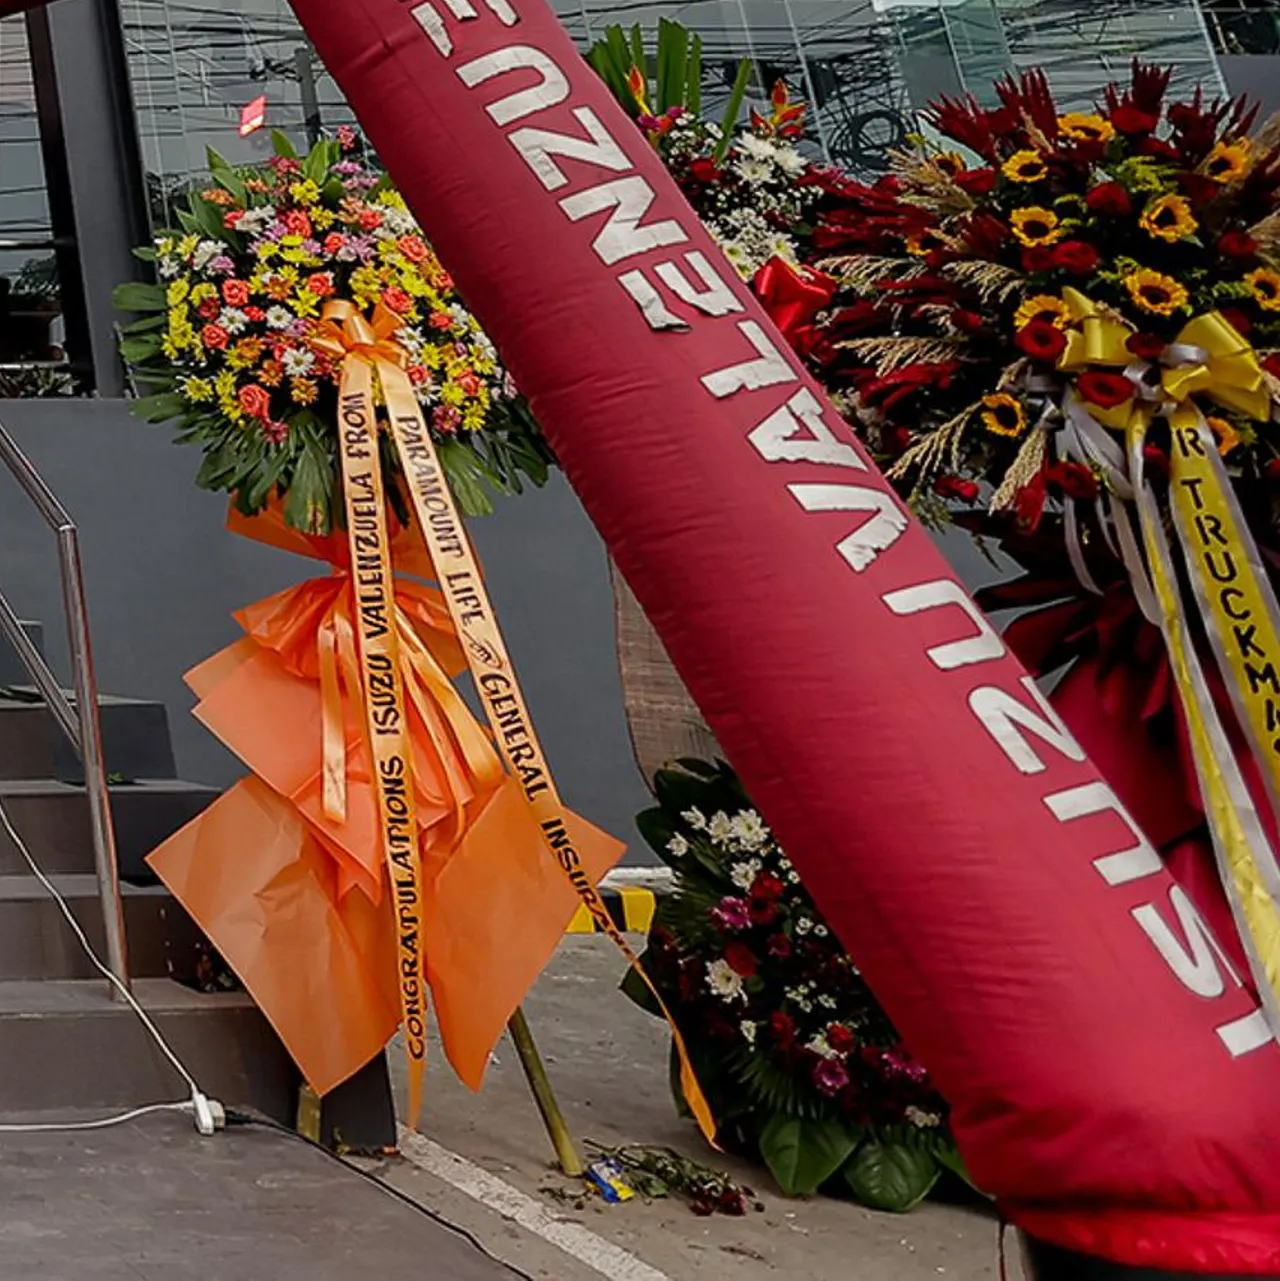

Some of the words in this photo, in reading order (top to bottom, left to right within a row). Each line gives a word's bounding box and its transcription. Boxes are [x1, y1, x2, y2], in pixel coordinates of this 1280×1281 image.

[342, 391, 376, 460] FROM
[346, 472, 390, 640] VALENZUELA
[397, 415, 465, 561] PARAMOUNT
[445, 571, 484, 629] LIFE
[478, 672, 548, 802] GENERAL
[370, 652, 401, 737] ISUZU
[376, 755, 426, 1061] CONGRATULATIONS
